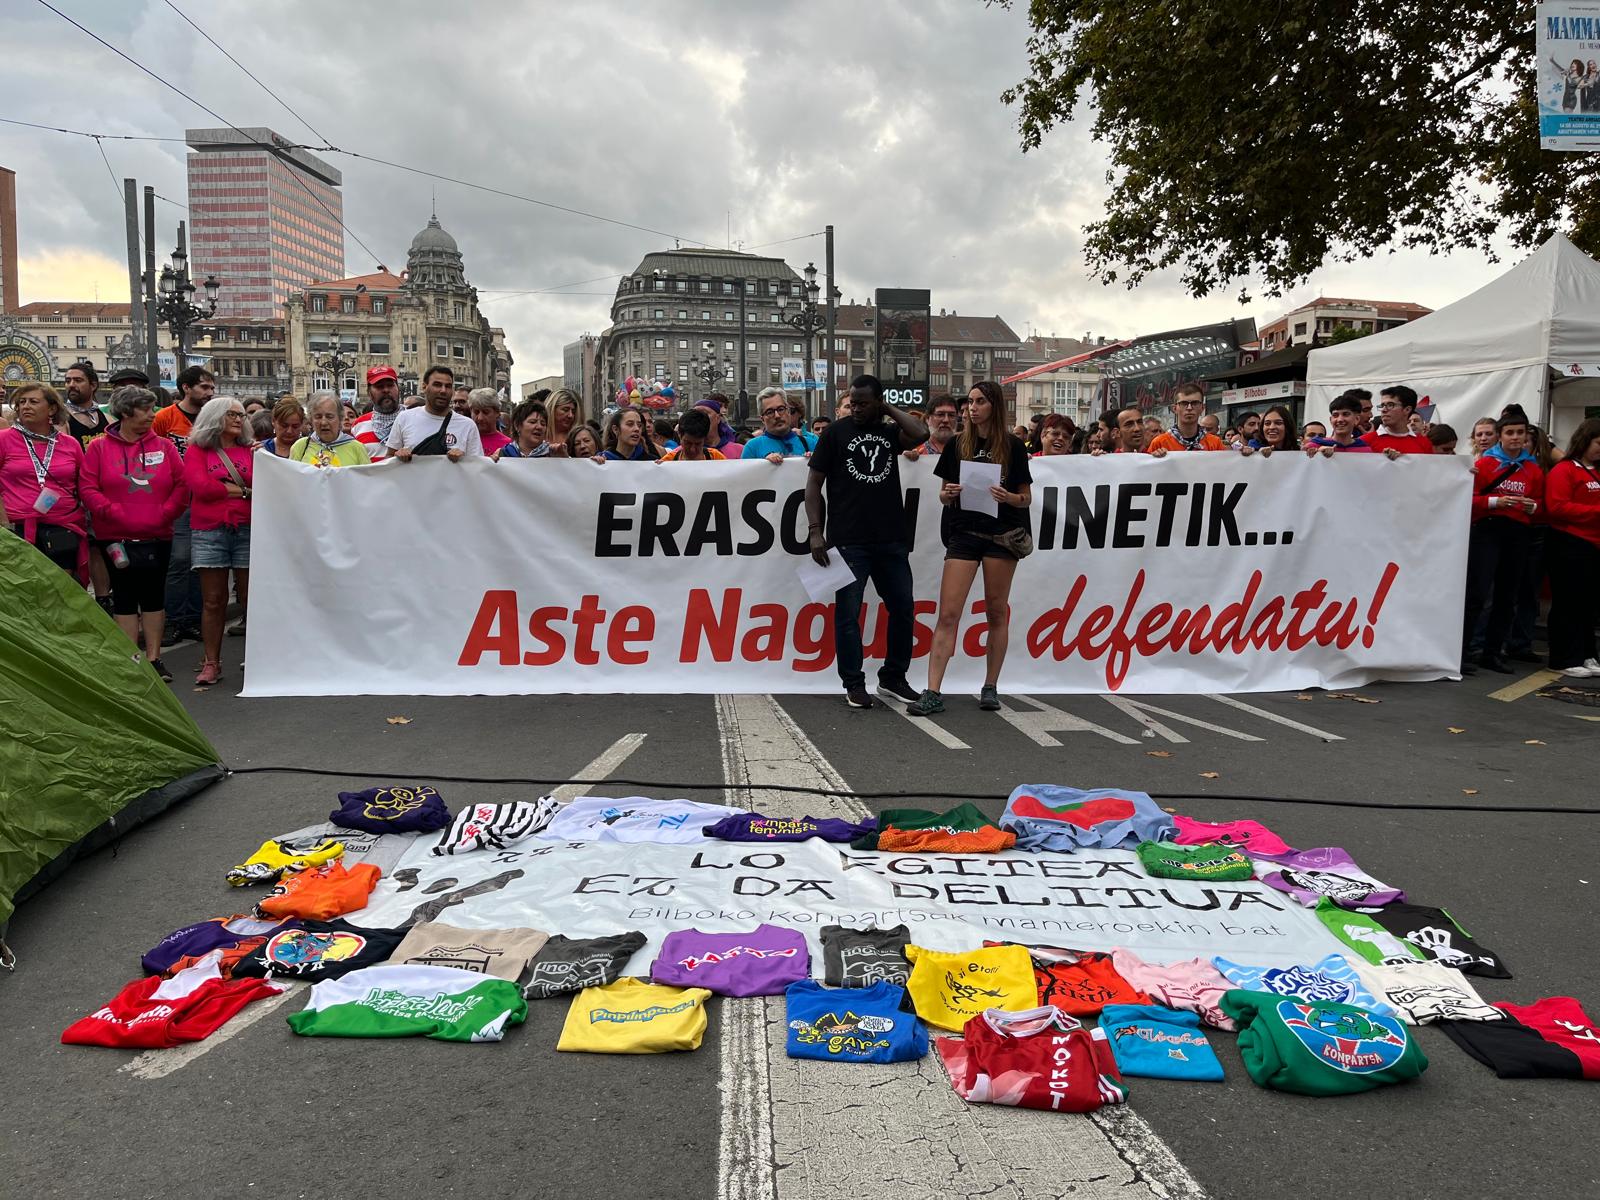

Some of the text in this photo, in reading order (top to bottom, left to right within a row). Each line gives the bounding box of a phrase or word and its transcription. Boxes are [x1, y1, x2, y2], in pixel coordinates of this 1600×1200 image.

[883, 389, 923, 404] 19:05
[1244, 388, 1268, 399] Bilbobus
[847, 434, 891, 452] BILBOKO
[594, 482, 1295, 557] ERASO INETIK...
[457, 561, 1400, 691] Aste Nagusa defendatu!
[690, 852, 785, 870] LO
[733, 876, 836, 900] DA
[891, 880, 1286, 911] DELITUA
[628, 907, 756, 921] Bilboko
[983, 914, 1212, 936] manteroekin
[1219, 920, 1287, 937] bat
[1322, 1044, 1383, 1067] KONPARTSA
